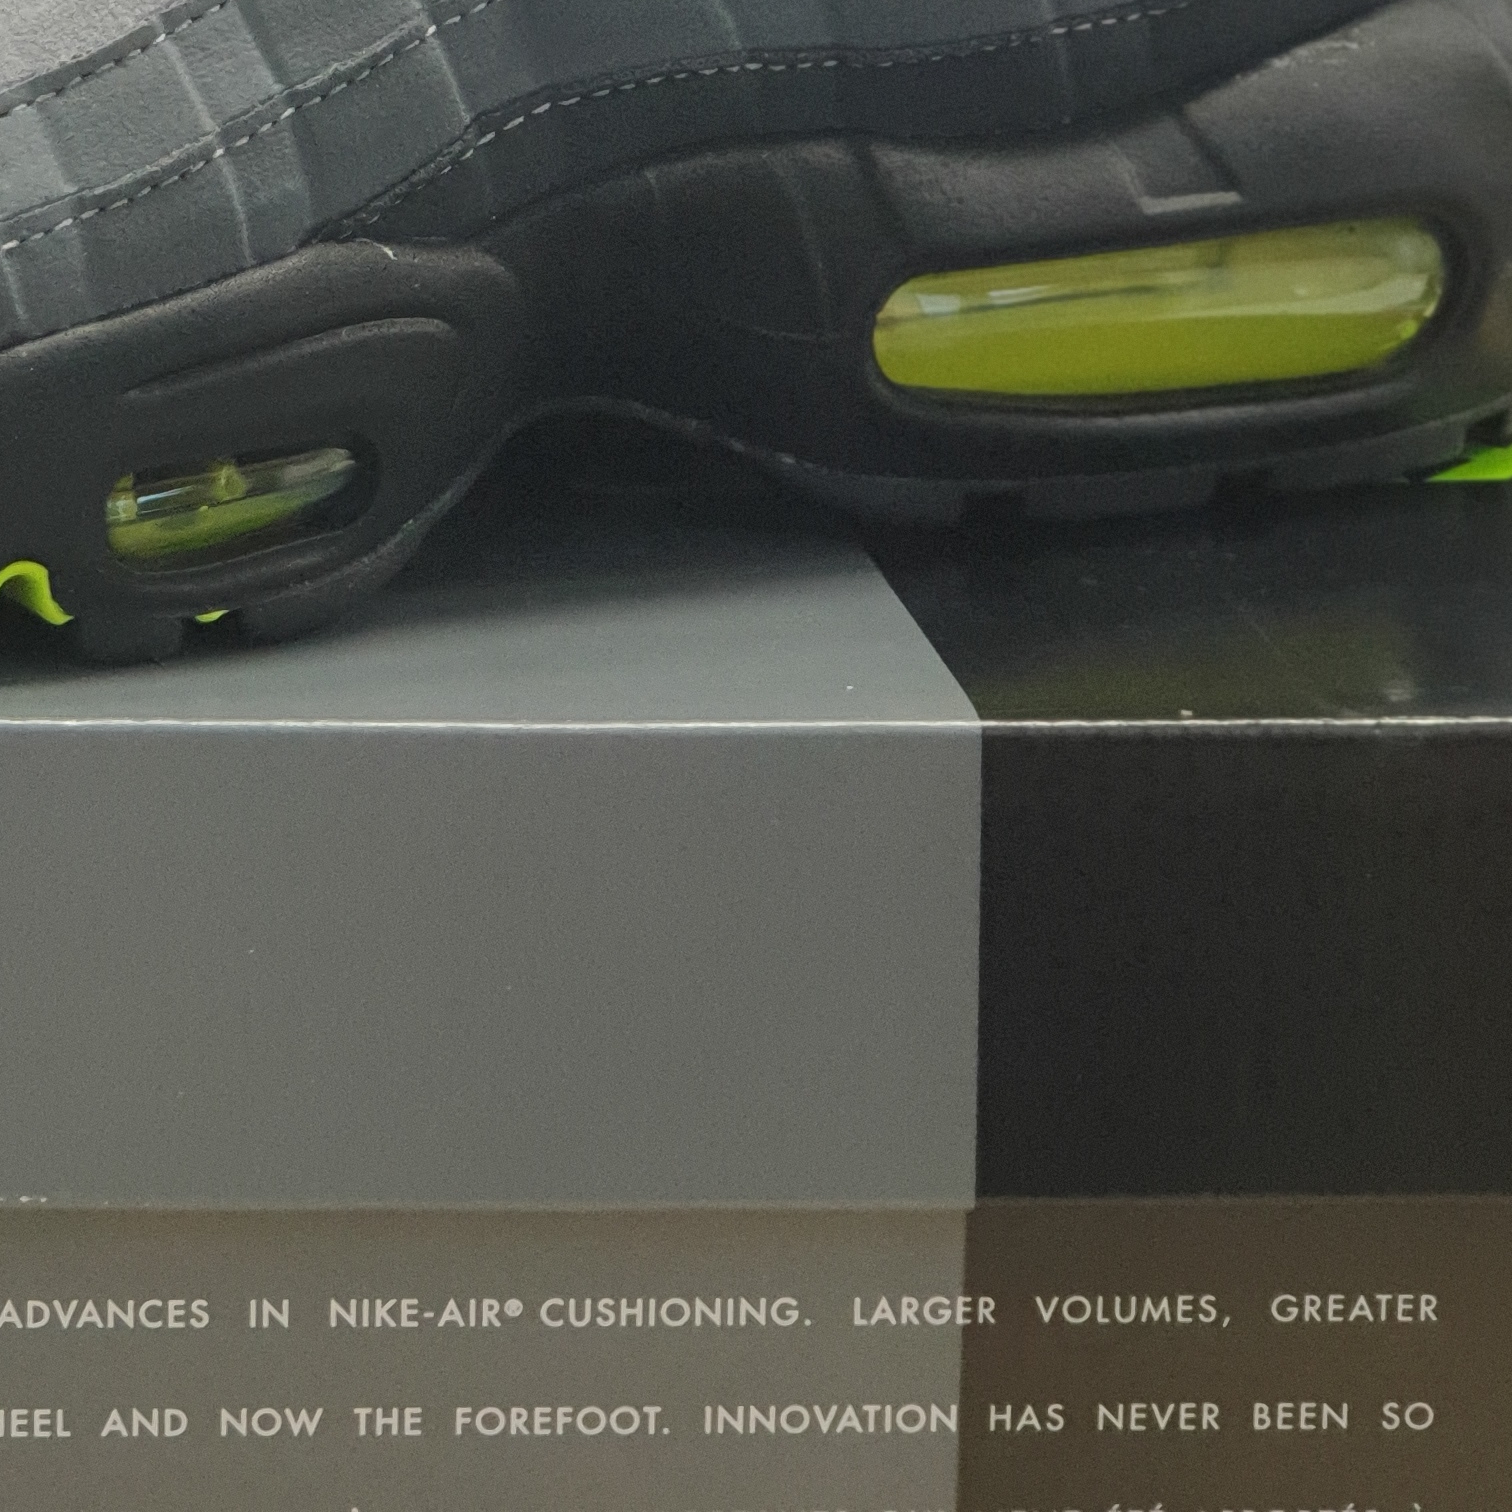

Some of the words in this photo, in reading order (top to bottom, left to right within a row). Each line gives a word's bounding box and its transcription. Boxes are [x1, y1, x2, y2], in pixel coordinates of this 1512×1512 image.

[249, 1298, 290, 1328] IN
[539, 1296, 812, 1328] CUSHIONING.
[853, 1295, 996, 1326] LARGER
[1034, 1293, 1231, 1328] VOLUMES,
[1270, 1293, 1438, 1323] GREATER
[100, 1408, 188, 1437] AND
[220, 1407, 323, 1437] NOW
[353, 1407, 422, 1436] THE
[455, 1405, 670, 1436] FOREFOOT.
[704, 1403, 958, 1434] INNOVATION
[988, 1402, 1065, 1432] HAS
[1097, 1401, 1220, 1432] NEVER
[1252, 1401, 1349, 1431] BEEN
[1381, 1401, 1435, 1431] SO
